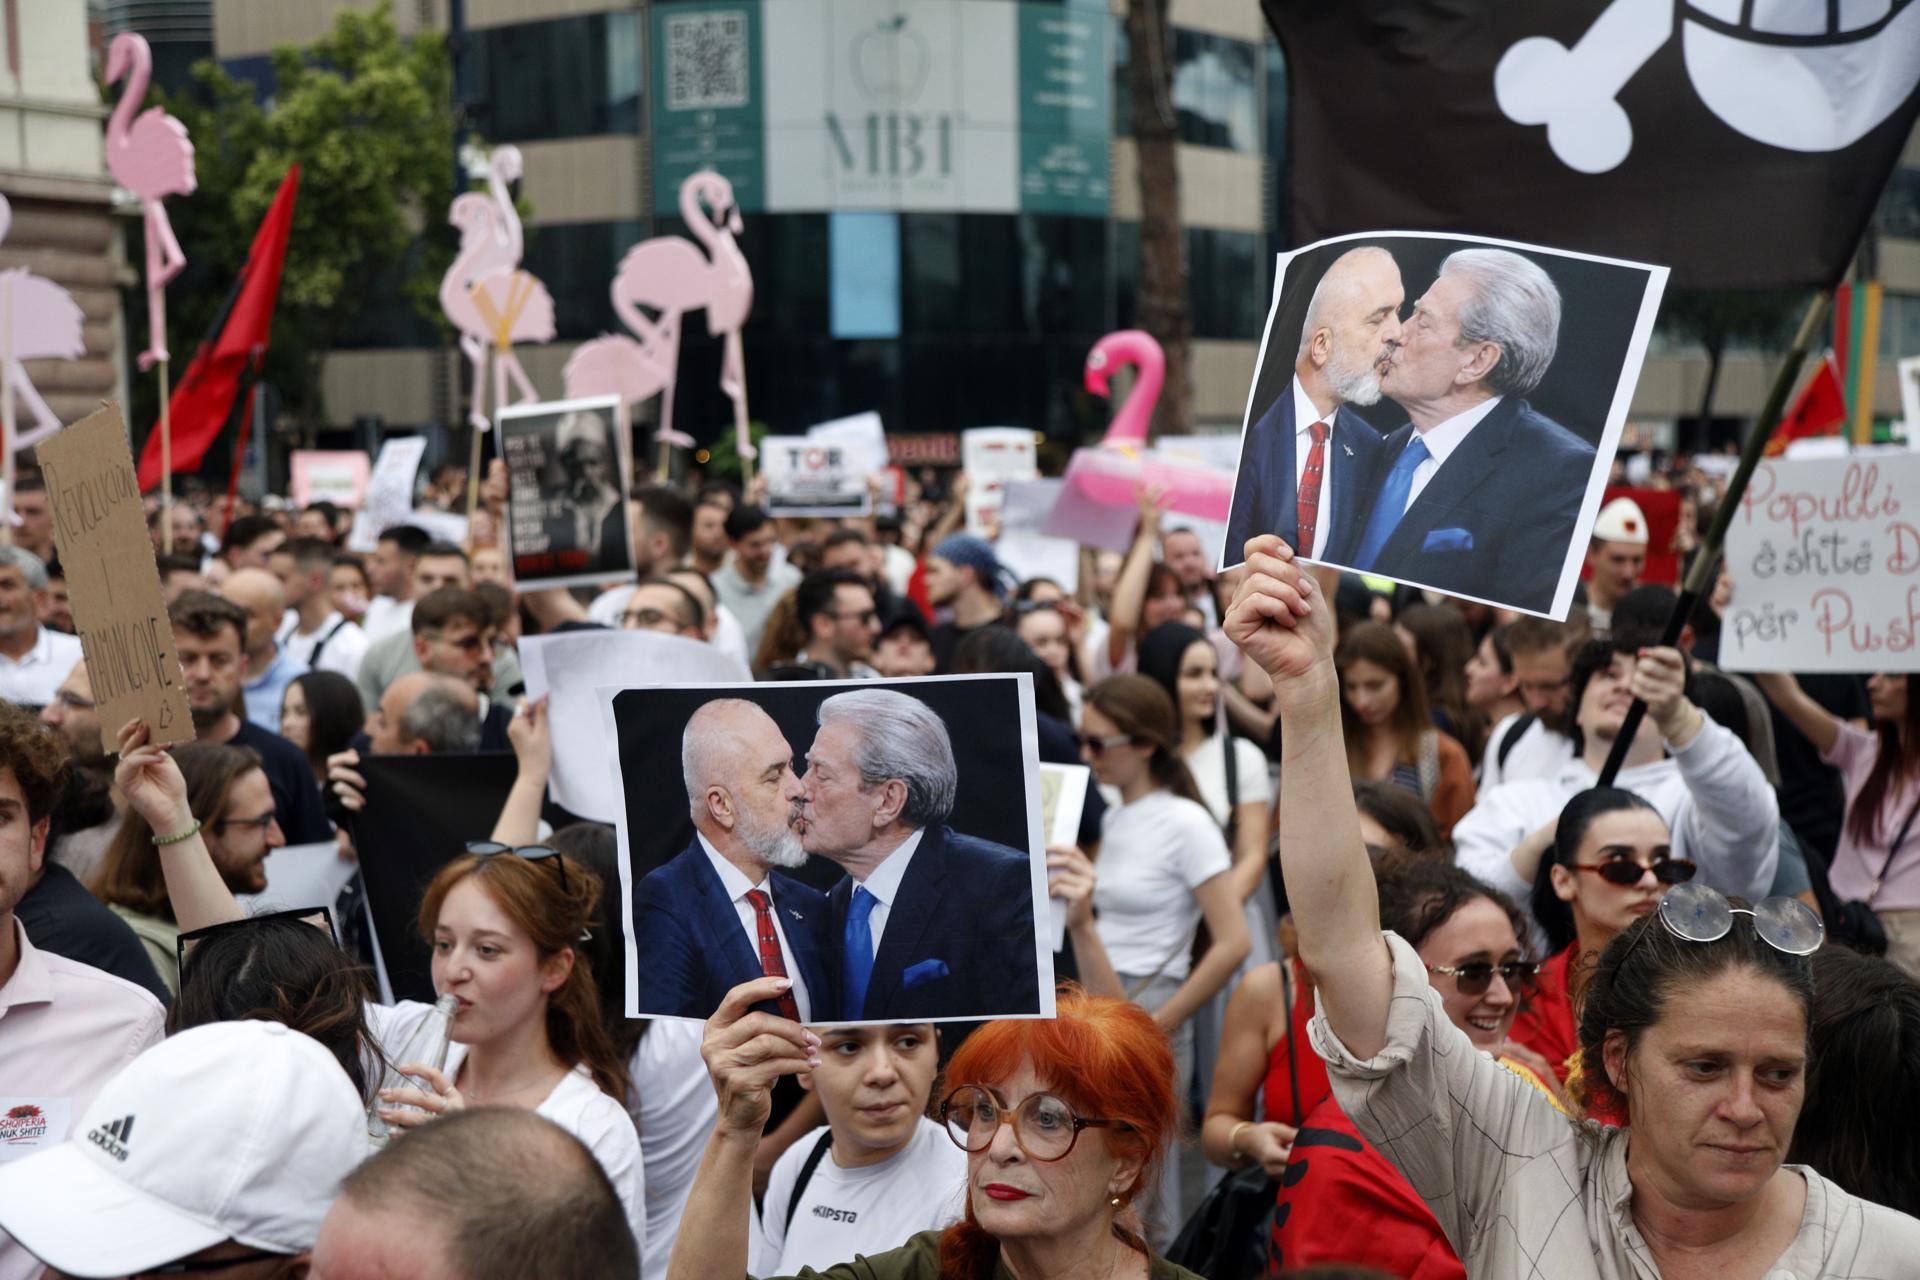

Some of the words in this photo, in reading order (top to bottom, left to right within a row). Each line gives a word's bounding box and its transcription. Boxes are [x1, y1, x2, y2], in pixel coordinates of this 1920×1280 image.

[1743, 462, 1901, 539] Populli
[1733, 603, 1798, 650] për
[0, 1129, 18, 1139] NUK
[20, 1126, 47, 1137] SHITET
[87, 1129, 129, 1162] adidas
